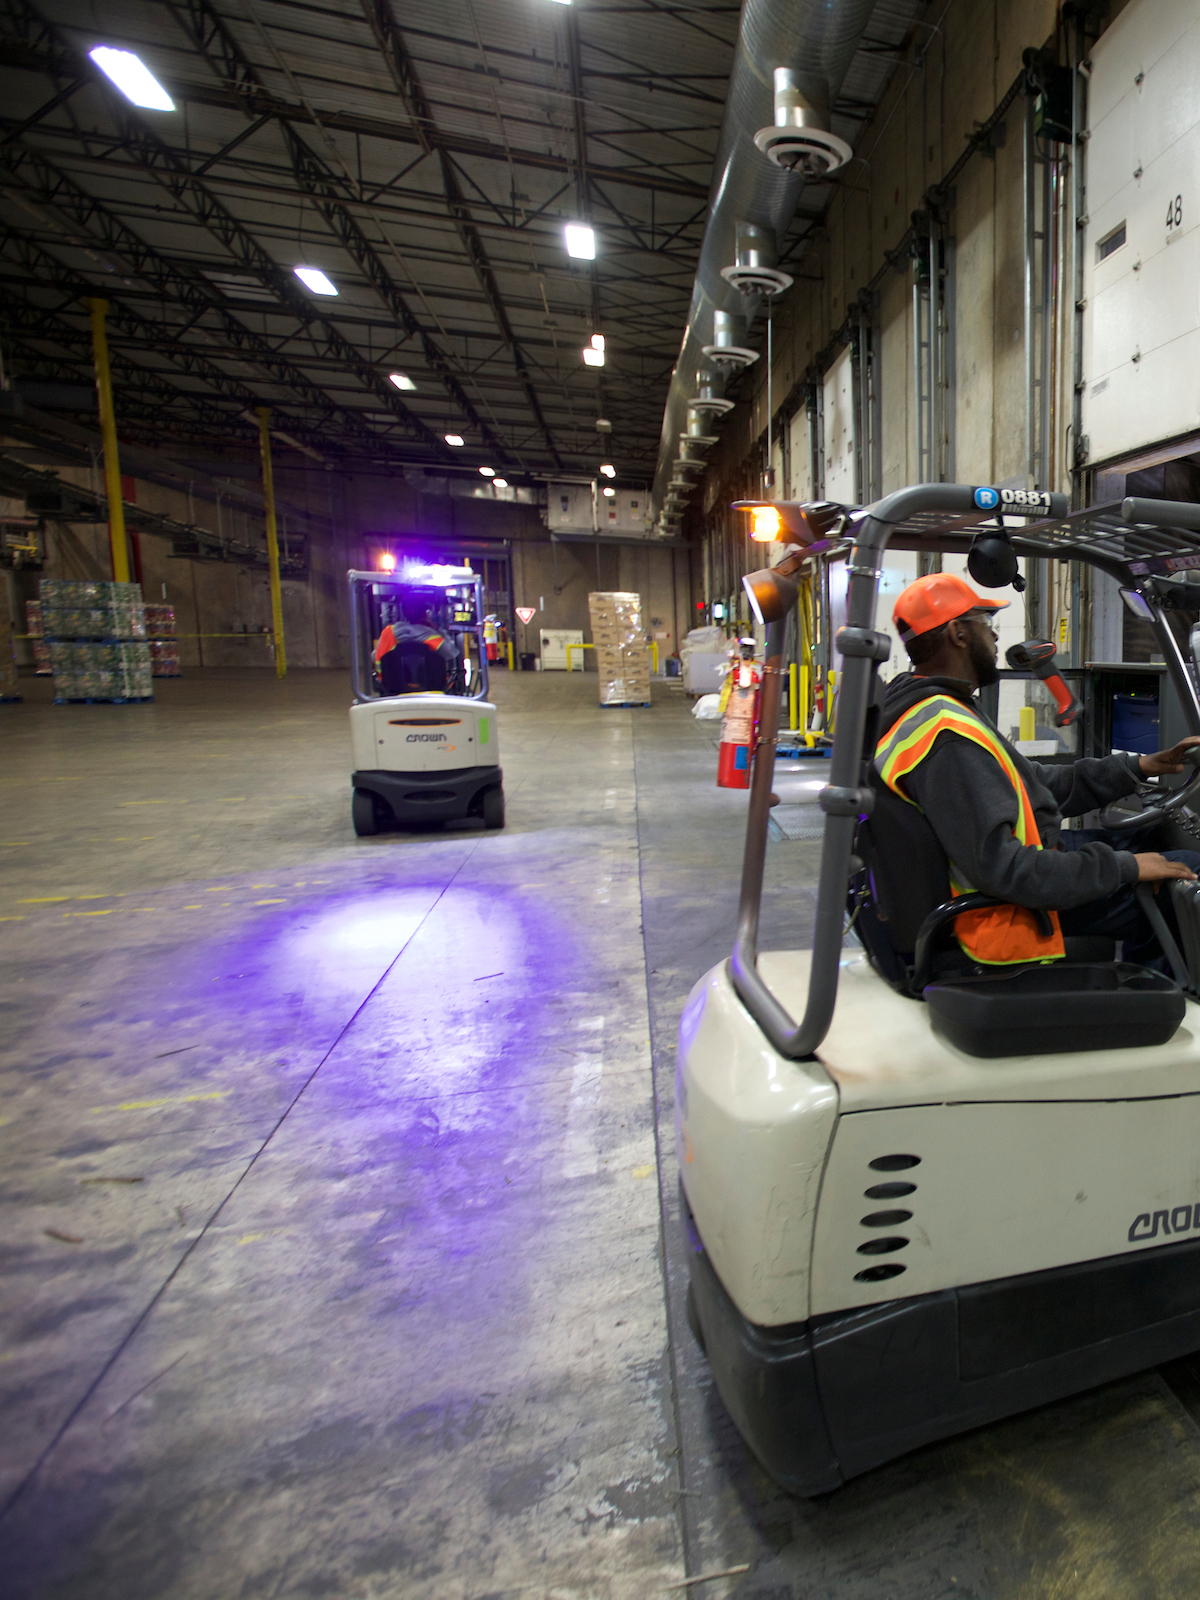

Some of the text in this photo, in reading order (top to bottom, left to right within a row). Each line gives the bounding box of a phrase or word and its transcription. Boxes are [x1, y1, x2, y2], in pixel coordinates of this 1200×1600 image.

[1165, 194, 1182, 230] 48
[1001, 489, 1051, 507] 0881
[406, 734, 447, 742] CROWN
